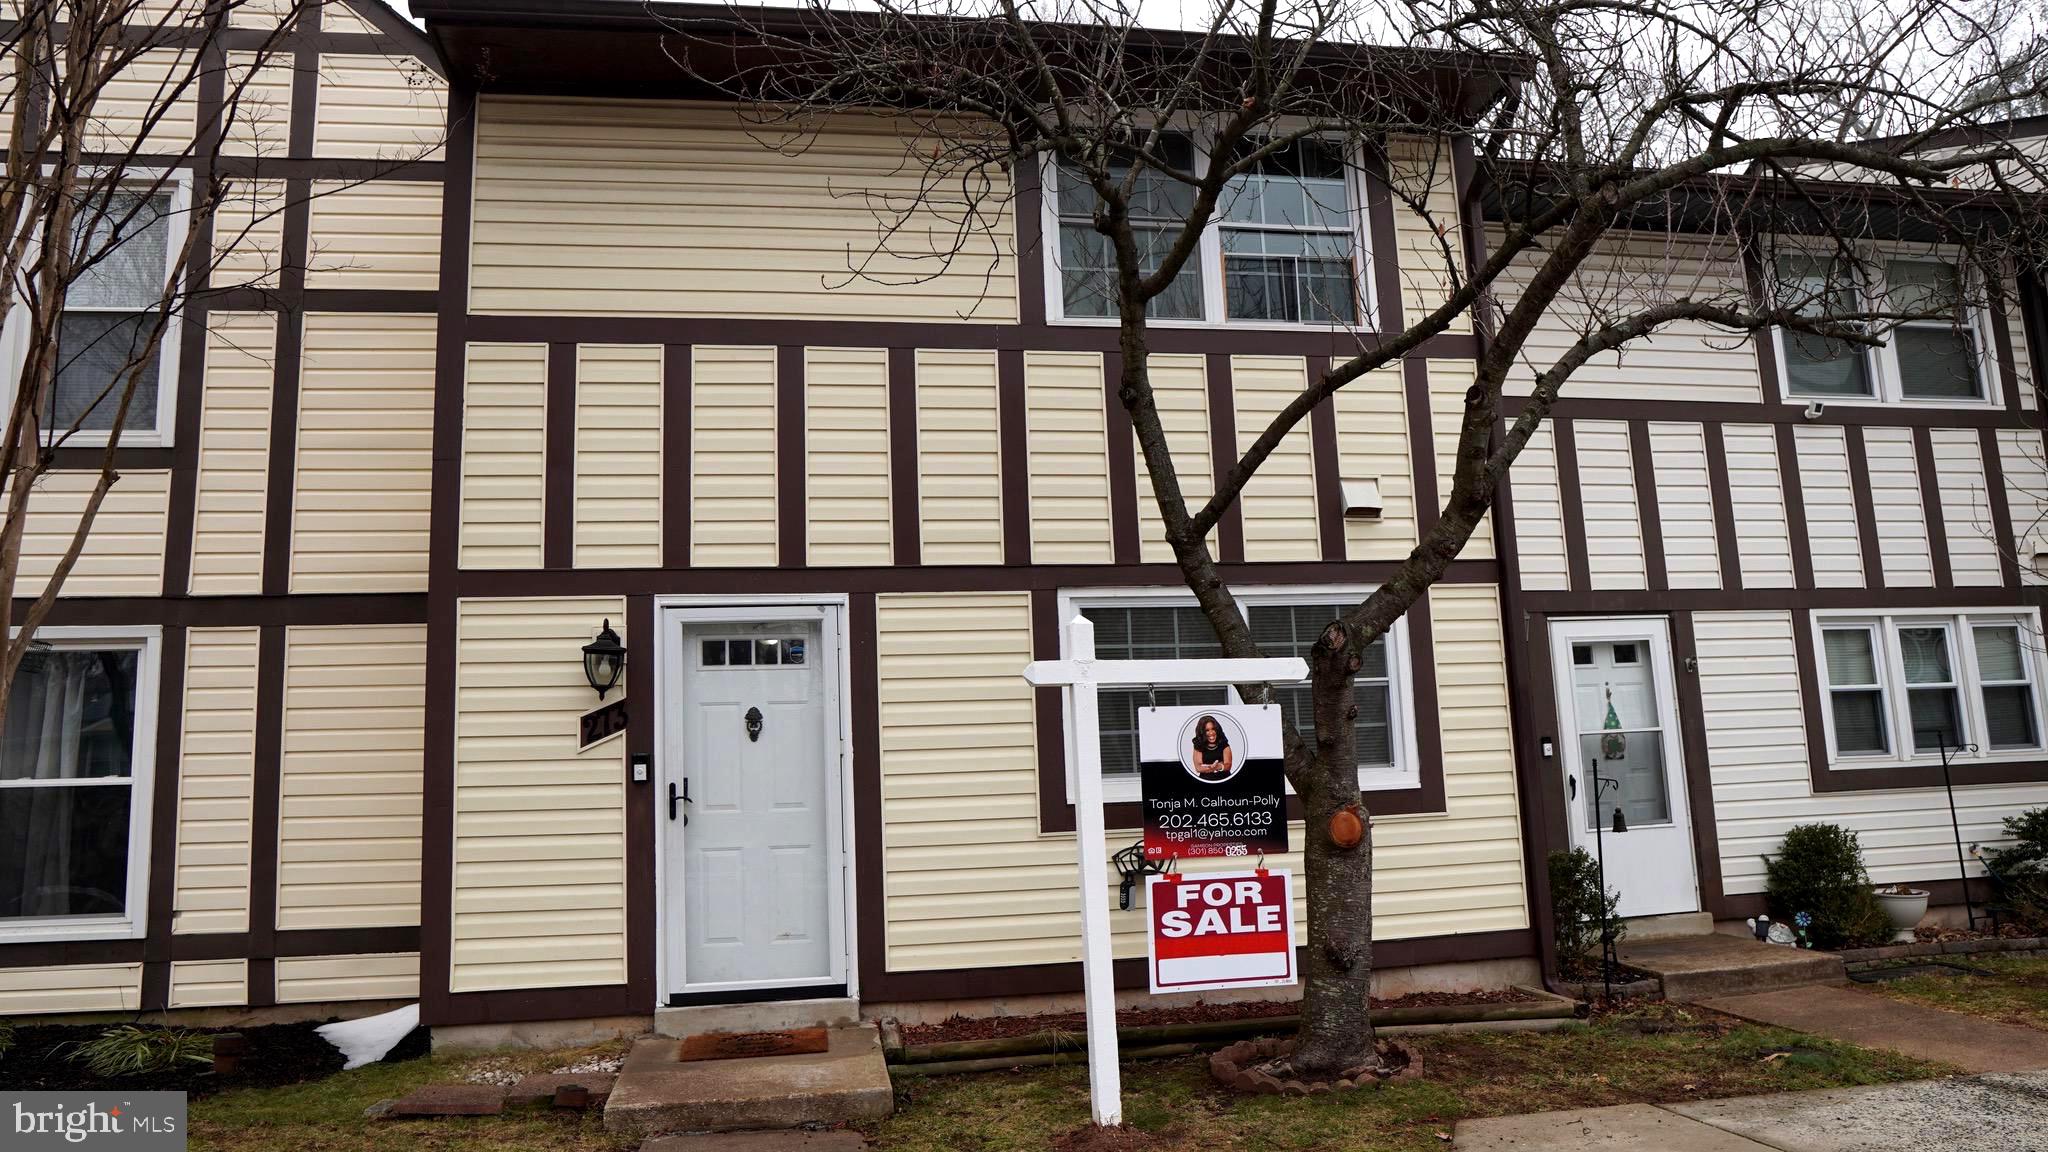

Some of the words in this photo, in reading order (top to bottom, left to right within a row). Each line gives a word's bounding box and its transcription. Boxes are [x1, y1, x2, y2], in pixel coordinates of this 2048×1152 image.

[1149, 798, 1181, 812] Tonja
[1184, 797, 1198, 808] M.
[1201, 794, 1280, 809] Calhoun-Polly
[1159, 811, 1273, 829] 202.465.6133
[1166, 827, 1267, 842] tpgal1@yahoo.com
[1188, 847, 1207, 856] (301)
[1176, 881, 1263, 908] FOR
[1161, 905, 1282, 938] SALE
